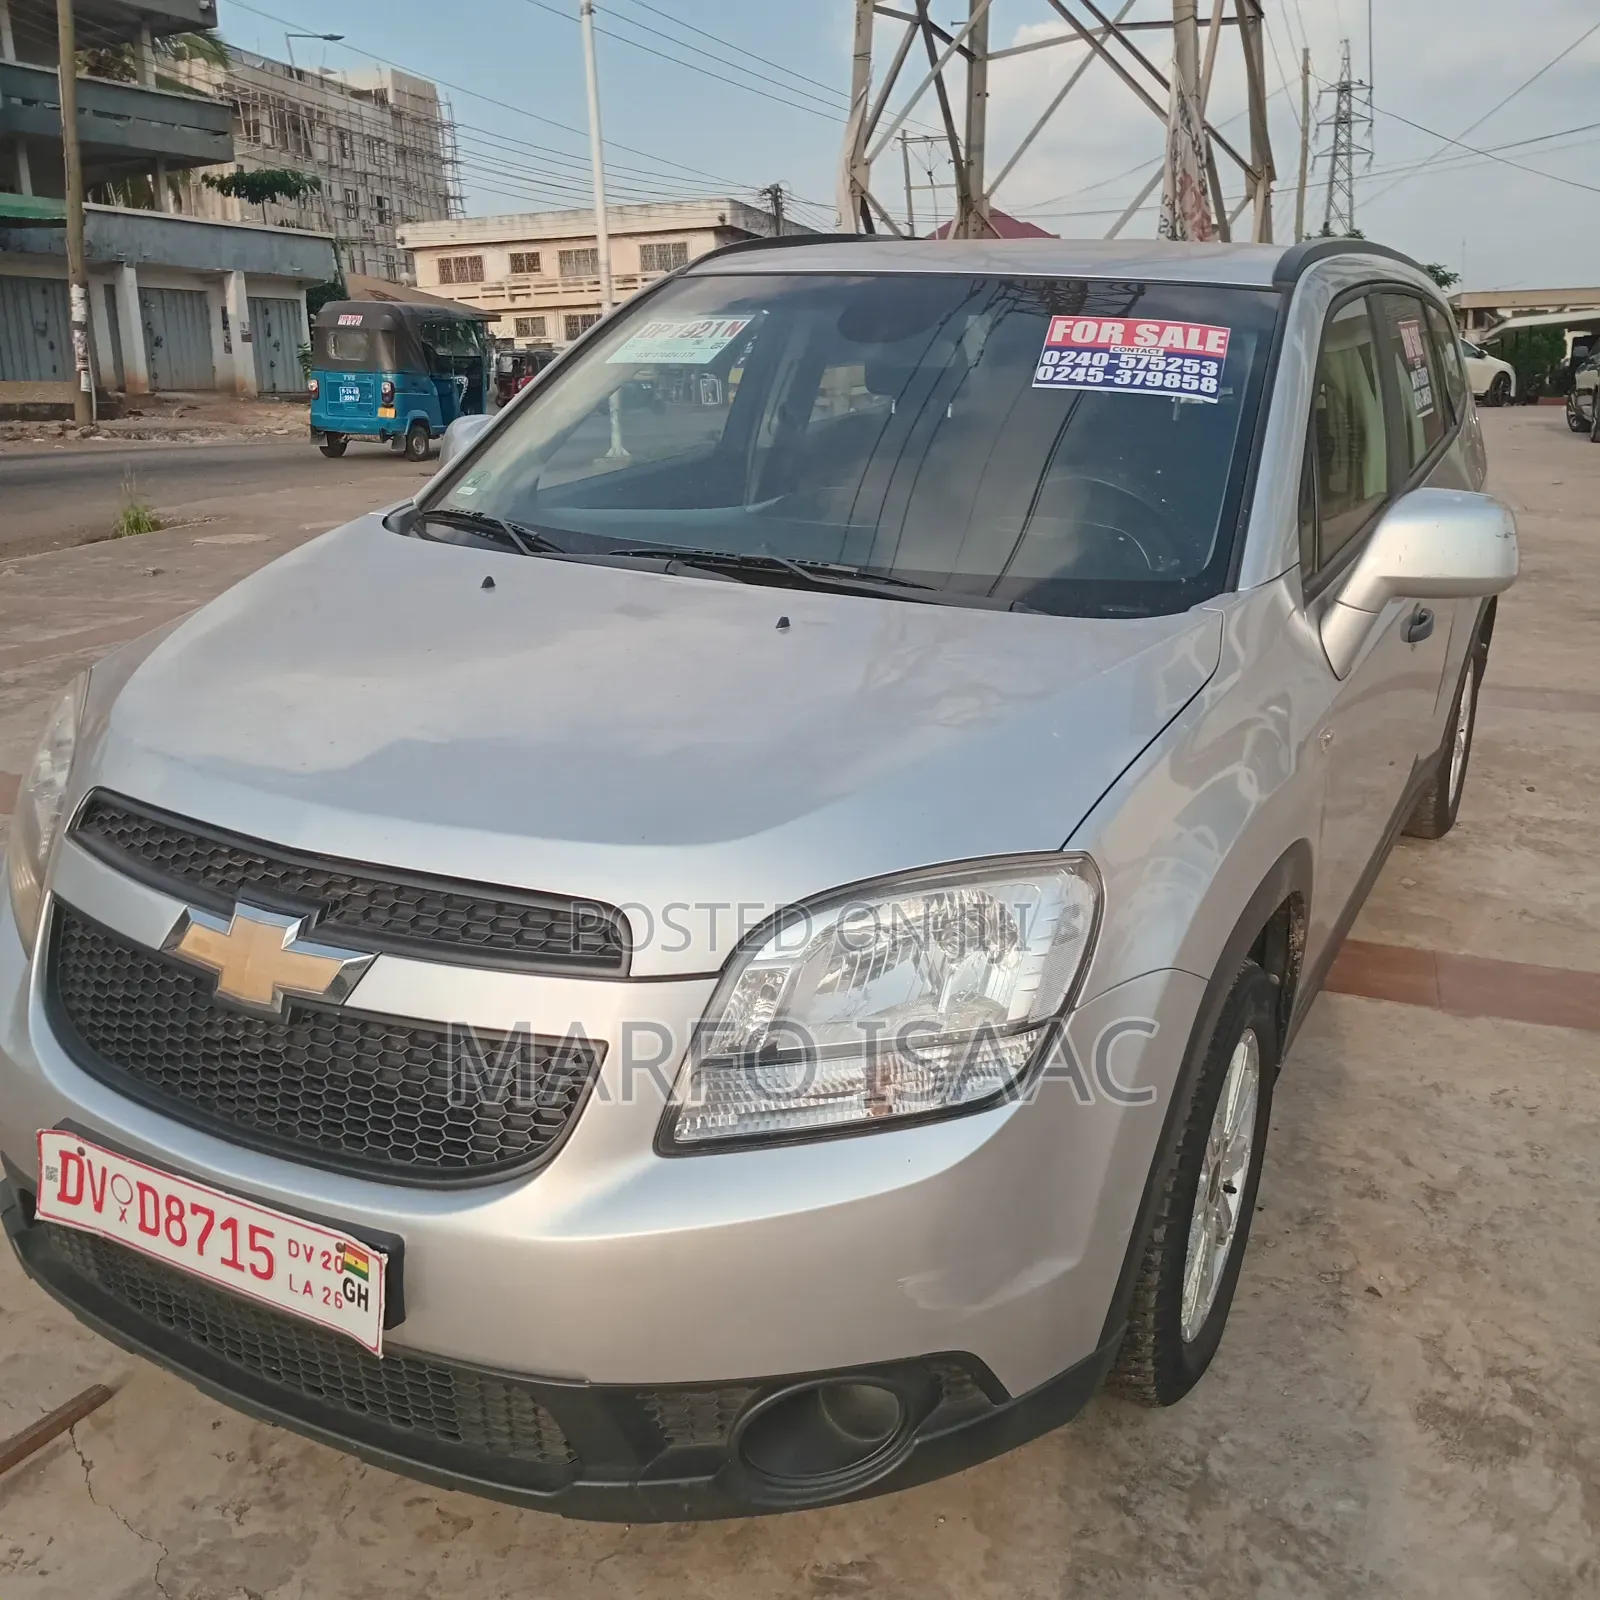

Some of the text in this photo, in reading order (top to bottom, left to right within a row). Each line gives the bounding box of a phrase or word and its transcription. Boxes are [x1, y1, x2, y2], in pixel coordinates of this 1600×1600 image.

[637, 324, 674, 339] DP
[719, 320, 747, 338] N
[1050, 320, 1227, 354] FOR SALE
[1042, 350, 1219, 377] 0240-575253
[1112, 346, 1161, 354] CONTACT
[1036, 365, 1218, 394] 0245-379858
[57, 1150, 276, 1281] DV D8715
[288, 1238, 345, 1275] DV 20
[289, 1273, 343, 1310] LA 26
[342, 1276, 369, 1313] GH
